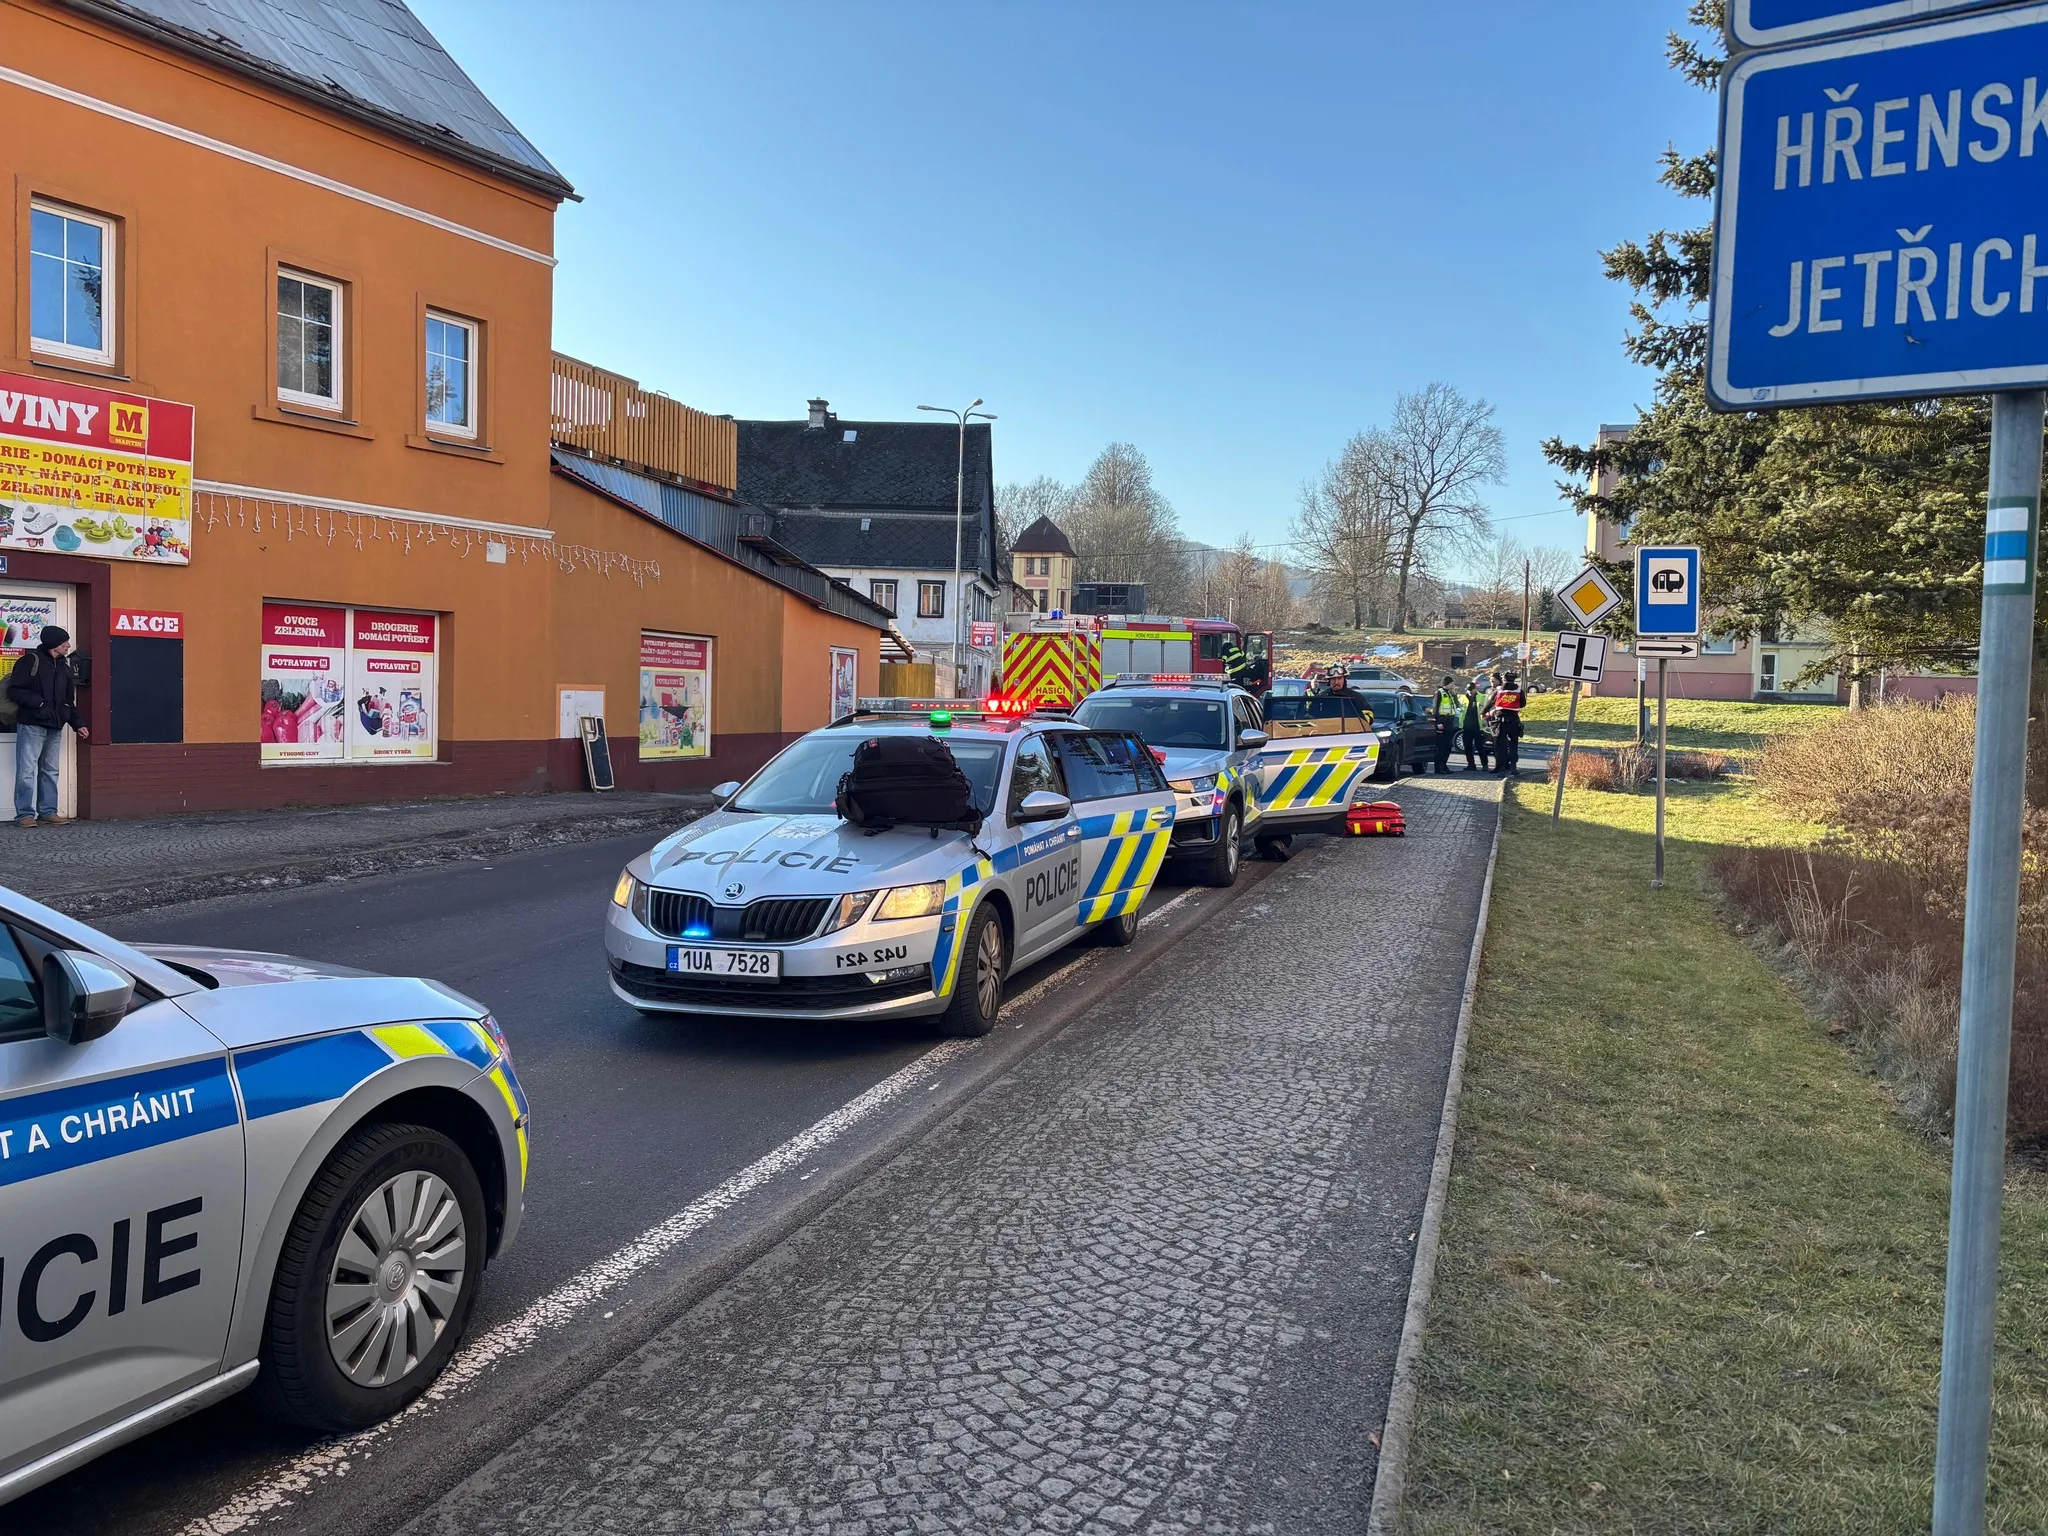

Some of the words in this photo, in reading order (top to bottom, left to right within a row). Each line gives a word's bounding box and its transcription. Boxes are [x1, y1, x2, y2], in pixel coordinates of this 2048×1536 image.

[116, 409, 142, 434] M
[114, 438, 142, 447] MARTIN
[42, 451, 103, 470] DOMÁCÍ
[106, 460, 177, 480] POTŘEBY
[0, 480, 82, 500] ZELENINA
[39, 467, 101, 486] NÁPOJE
[112, 477, 181, 497] ALKOHOL
[116, 614, 179, 633] AKCE
[284, 615, 318, 626] OVOCE
[371, 621, 418, 633] DROGERIE
[274, 625, 326, 637] ZELENINA
[358, 631, 390, 641] DOMÁCÍ
[391, 632, 430, 644] POTŘEBY
[271, 658, 318, 668] POTRAVINY
[369, 662, 410, 671] POTRAVINY
[1035, 686, 1066, 695] HASIČI
[1024, 841, 1045, 857] POMÁHAT
[1049, 833, 1066, 847] CHRÁNIT
[672, 850, 860, 875] POLICIE
[1025, 857, 1078, 912] POLICIE
[683, 950, 713, 971] 1UA
[727, 952, 770, 974] 7528
[28, 1123, 50, 1153] A
[60, 1087, 196, 1144] CHRÁNIT
[0, 1196, 204, 1342] CIE
